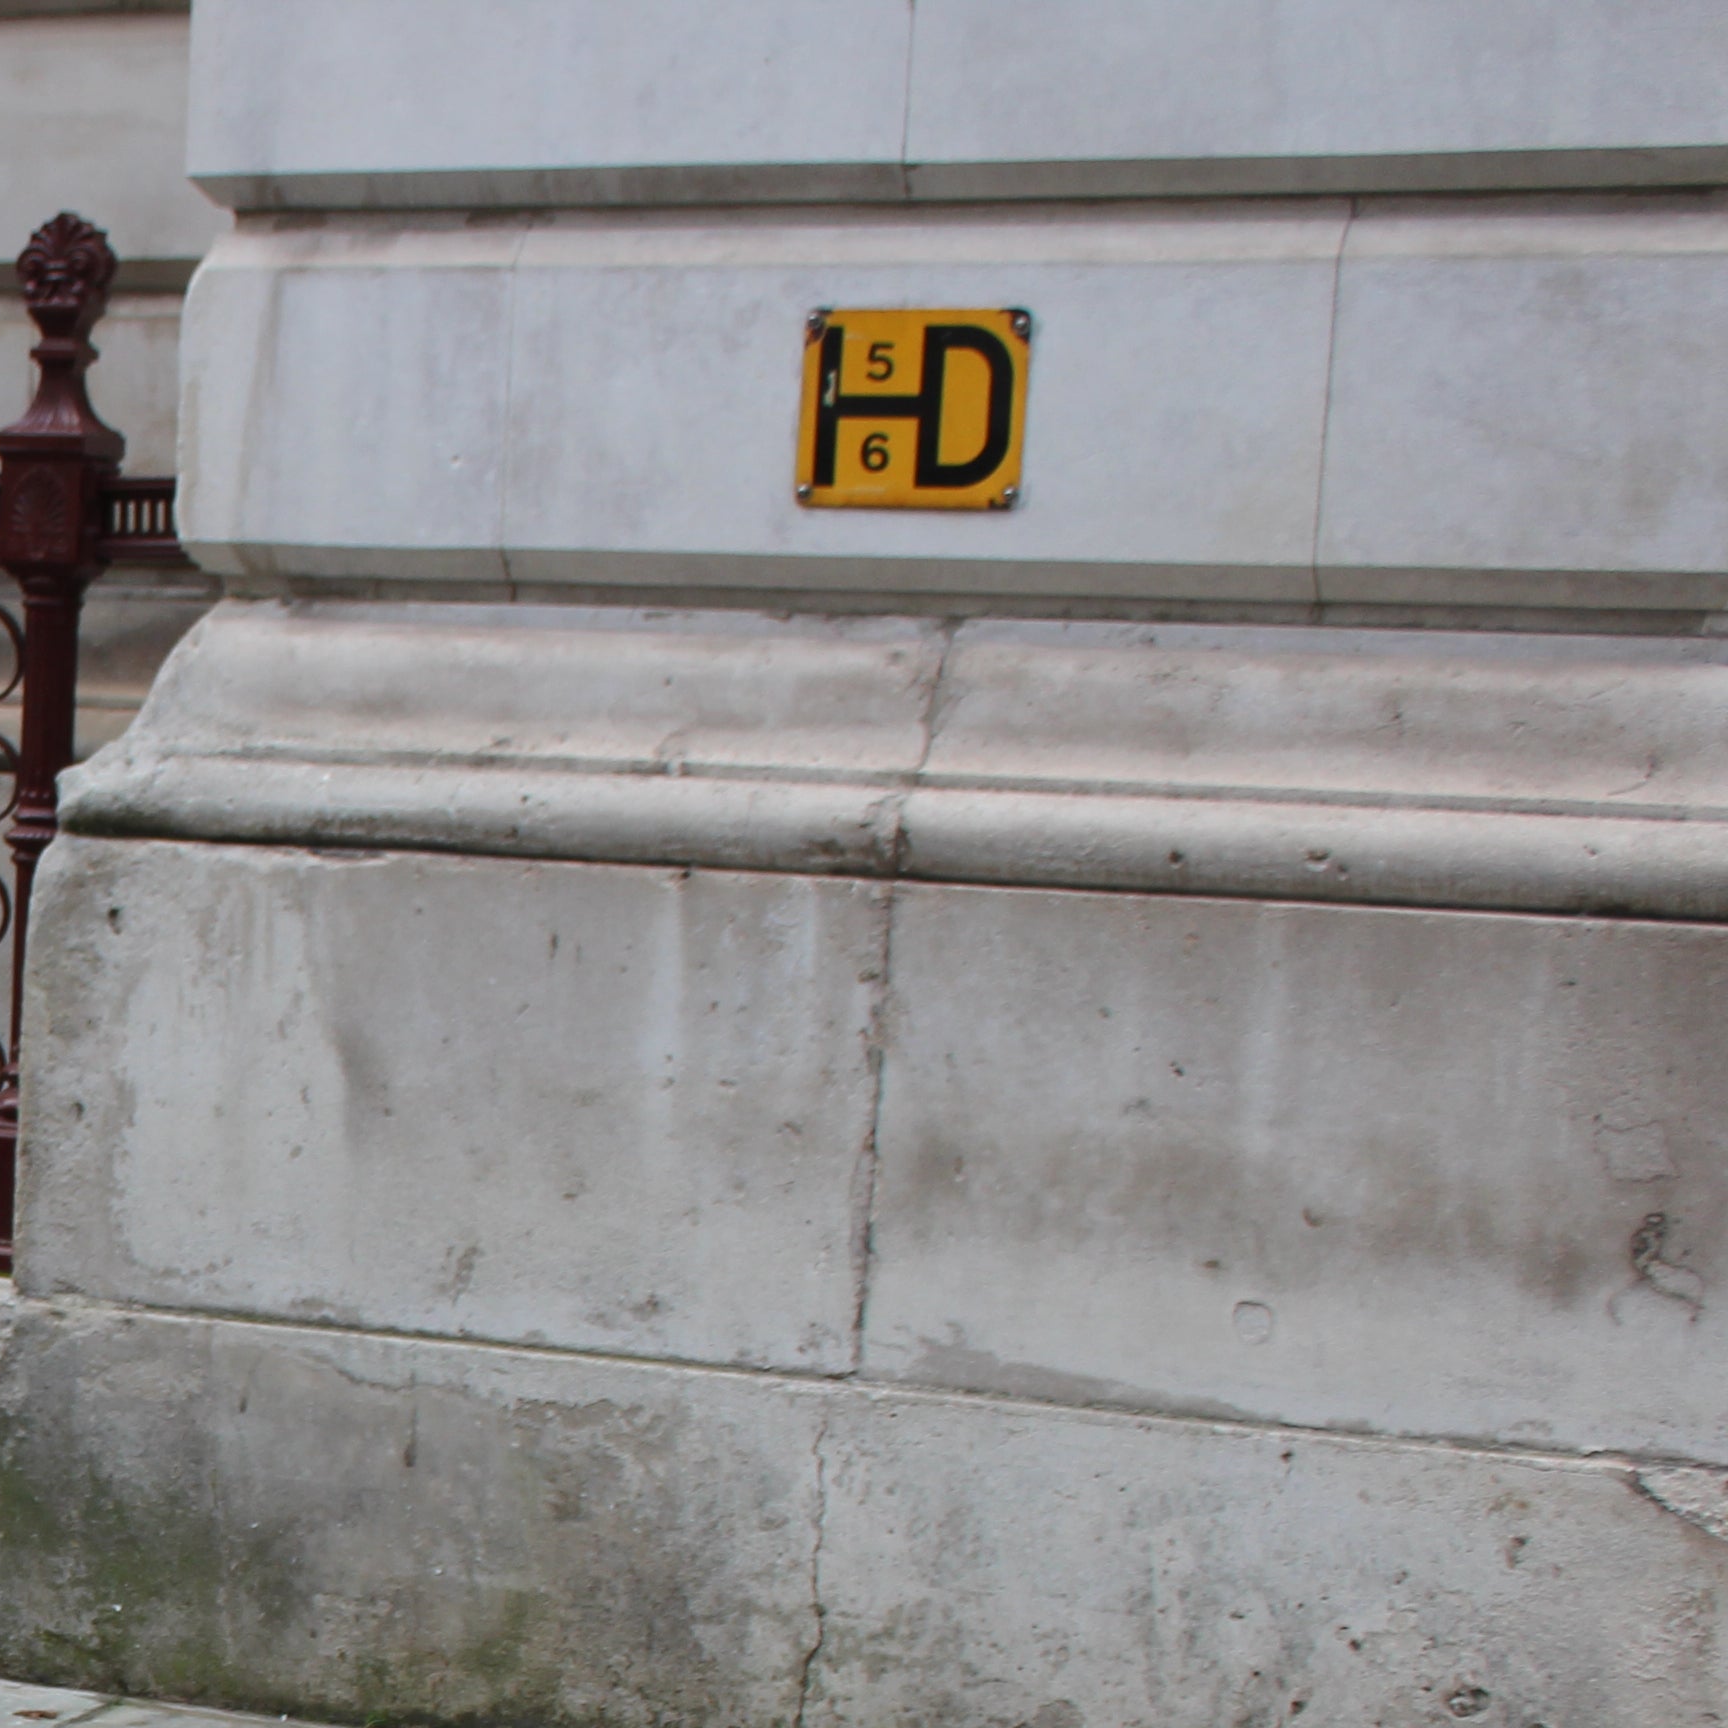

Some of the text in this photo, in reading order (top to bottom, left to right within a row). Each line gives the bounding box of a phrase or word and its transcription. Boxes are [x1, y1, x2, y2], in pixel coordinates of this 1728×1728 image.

[865, 341, 895, 381] 5
[812, 323, 1014, 489] HD
[859, 432, 890, 472] 6
